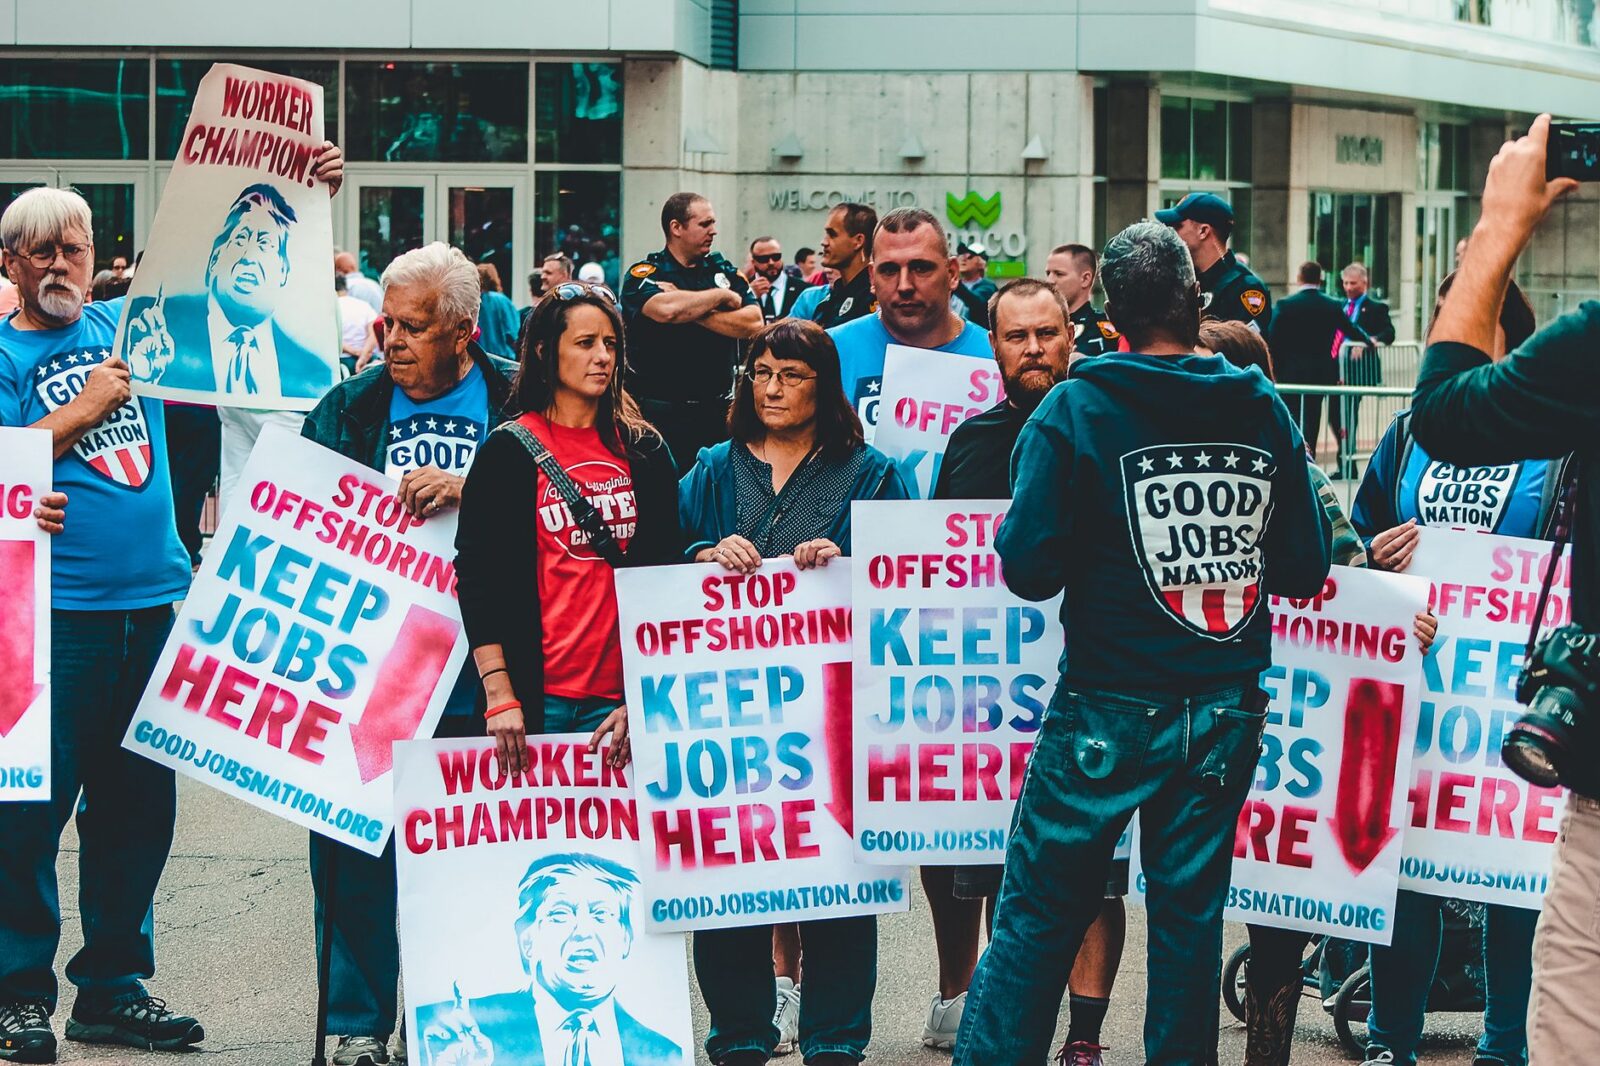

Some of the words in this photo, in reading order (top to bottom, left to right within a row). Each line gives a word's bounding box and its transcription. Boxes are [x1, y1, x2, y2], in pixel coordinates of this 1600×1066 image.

[221, 76, 314, 136] WORKER
[182, 124, 325, 188] CHAMPION?
[80, 423, 146, 457] NATION
[390, 439, 473, 470] GOOD
[1423, 482, 1501, 509] JOBS
[1431, 461, 1510, 483] GOOD
[1145, 480, 1262, 519] GOOD
[1425, 506, 1493, 528] NATION
[1155, 522, 1255, 563] JOBS
[216, 524, 390, 635] KEEP
[701, 572, 797, 612] STOP
[868, 554, 1007, 589] OFFSH
[1162, 557, 1258, 587] NATION
[188, 593, 368, 700] JOBS
[635, 607, 852, 657] OFFSHORIN
[869, 606, 1046, 666] KEEP
[159, 642, 342, 766] HERE
[640, 664, 805, 734] KEEP
[866, 673, 1048, 735] JOBS
[134, 719, 384, 843] GOODJOBSNATION.ORG
[645, 731, 815, 800] JOBS
[404, 796, 641, 855] CHAMPION
[651, 798, 821, 871] HERE
[860, 828, 1009, 852] GOODJOBSN
[651, 878, 904, 922] GOODJOBSNATION.ORG
